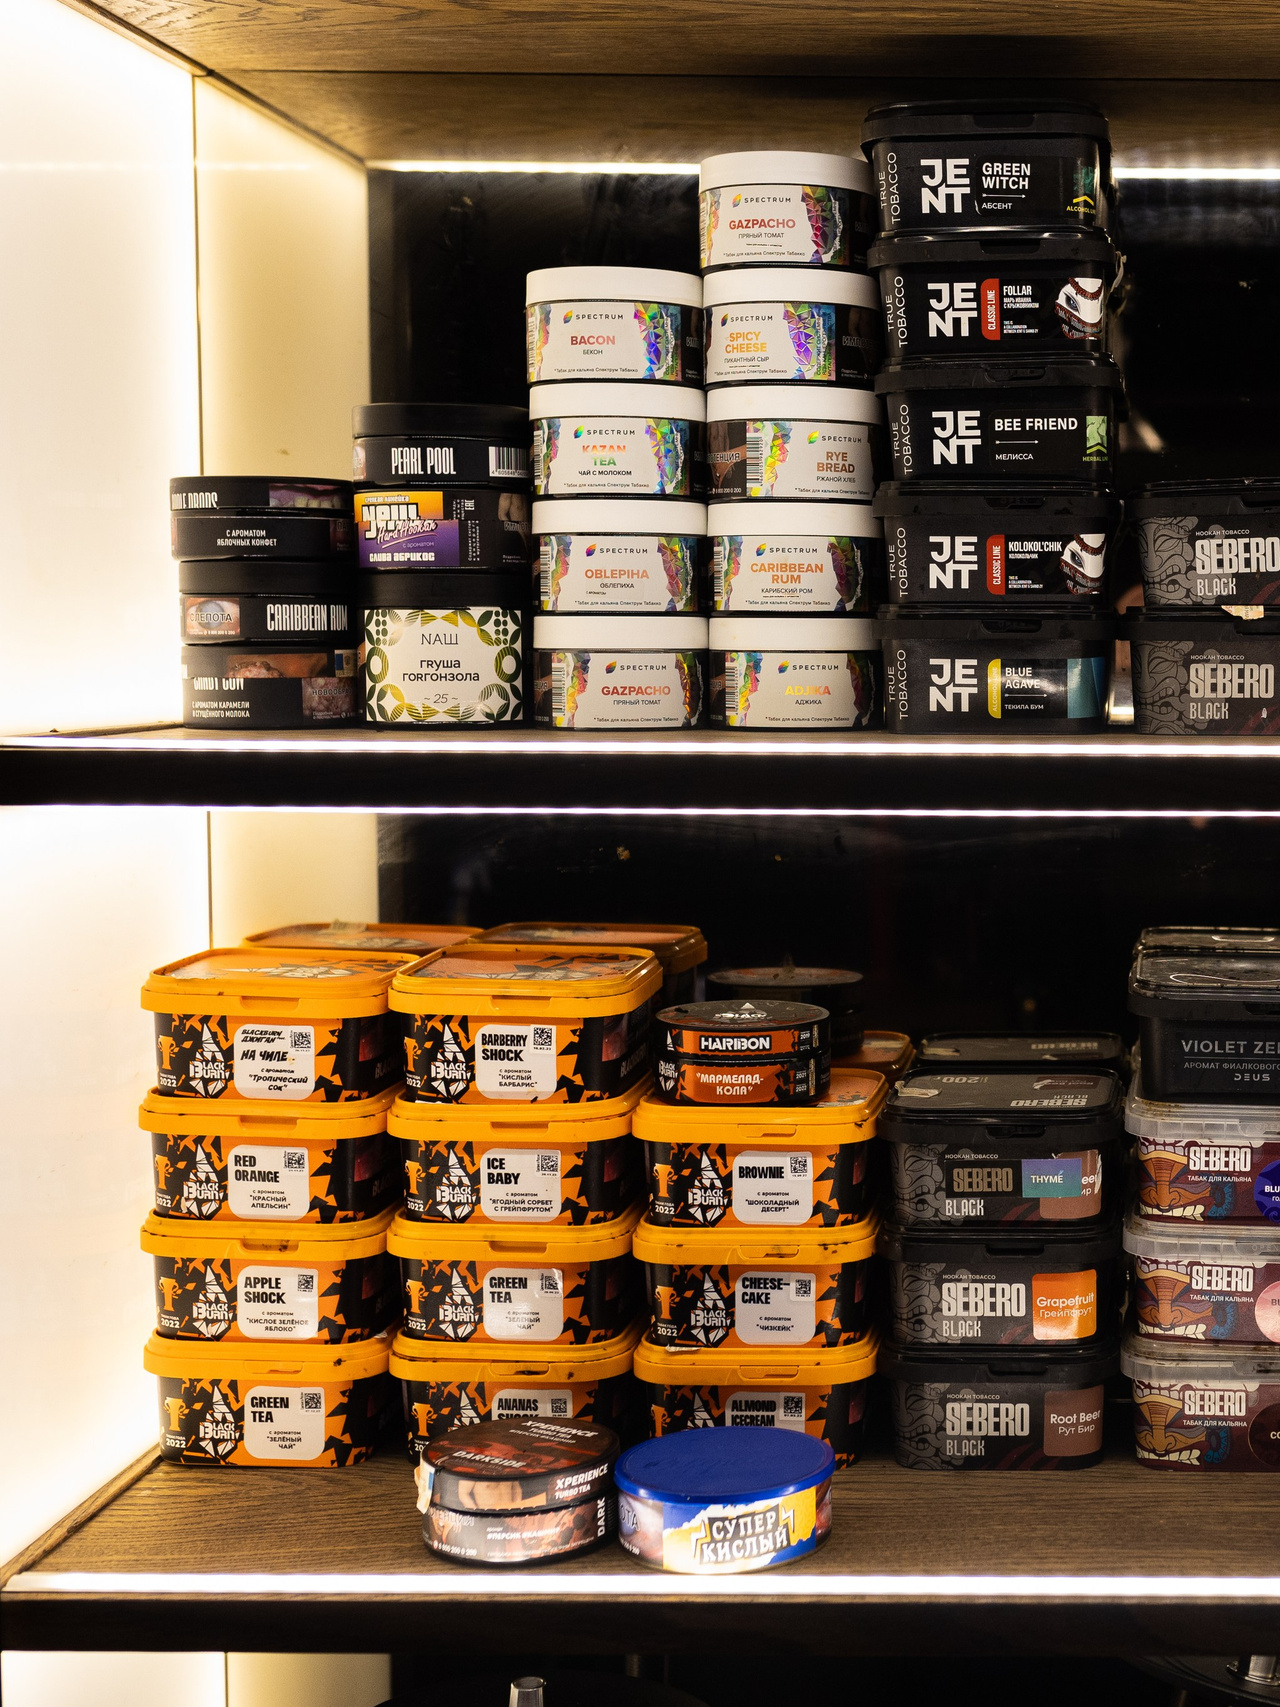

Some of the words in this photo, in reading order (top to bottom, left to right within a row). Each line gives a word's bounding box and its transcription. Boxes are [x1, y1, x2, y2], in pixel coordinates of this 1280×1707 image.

[982, 162, 1030, 176] GREEN
[887, 152, 900, 224] TOBACCO
[982, 176, 1028, 190] WITCH
[744, 196, 791, 204] SPECTRUM
[982, 202, 1012, 210] АБСЕНТ
[729, 218, 796, 230] GAZPACHO
[1003, 286, 1032, 296] FOLLAR
[570, 335, 615, 345] BACON
[729, 331, 761, 342] SPICY
[725, 342, 767, 354] CHEESE
[994, 419, 1021, 431] BEE
[1025, 418, 1078, 431] FRIEND
[582, 445, 626, 454] KAZAN
[391, 448, 424, 475] PEARL
[427, 448, 456, 474] POOL
[592, 456, 616, 466] TEA
[826, 452, 848, 461] RYE
[817, 462, 855, 473] BREAD
[233, 530, 266, 538] АРОМАТОМ
[217, 538, 249, 546] ЯБЛОЧНЫХ
[1008, 541, 1062, 552] KOLOKOL'CHIK
[1195, 537, 1280, 575] SEBERO
[585, 569, 649, 579] OBLEPIHA
[750, 562, 823, 574] CARIBBEAN
[772, 574, 801, 584] RUM
[1197, 578, 1236, 596] BLACK
[190, 613, 232, 622] СЛЕПОТА
[1005, 667, 1032, 677] BLUE
[1005, 679, 1040, 689] AGAVE
[785, 686, 831, 695] ADJIKA
[434, 693, 449, 704] 25
[482, 1033, 528, 1047] BARBERRY
[701, 1037, 770, 1050] HARIBON
[1182, 1040, 1246, 1054] VIOLET
[241, 1050, 255, 1061] НА
[260, 1051, 288, 1062] ЧИЛЕ
[482, 1049, 524, 1062] SHOCK
[1184, 1062, 1219, 1070] АРОМАТ
[234, 1155, 256, 1166] RED
[487, 1158, 505, 1169] ICE
[234, 1170, 280, 1182] ORANGE
[487, 1173, 520, 1184] BABY
[739, 1166, 784, 1179] BROWNIE
[953, 1168, 1013, 1192] SEBERO
[655, 1205, 675, 1214] 2022
[244, 1277, 281, 1289] APPLE
[489, 1277, 527, 1289] GREEN
[490, 1292, 512, 1303] TEA
[741, 1292, 770, 1304] CAKE
[1037, 1293, 1094, 1308] Grapefruit
[1039, 1306, 1092, 1318] Грейпфрут
[732, 1400, 776, 1412] ALMOND
[732, 1415, 774, 1426] ICECREAM
[1050, 1414, 1077, 1424] Root
[1079, 1410, 1100, 1423] Beer
[1059, 1426, 1075, 1434] Рут
[1078, 1424, 1095, 1434] Бир
[452, 1450, 526, 1468] DARKSIDE
[555, 1464, 608, 1490] XPERIENCE
[713, 1512, 776, 1541] СУПЕР
[700, 1532, 788, 1566] КИСЛЫЙ
